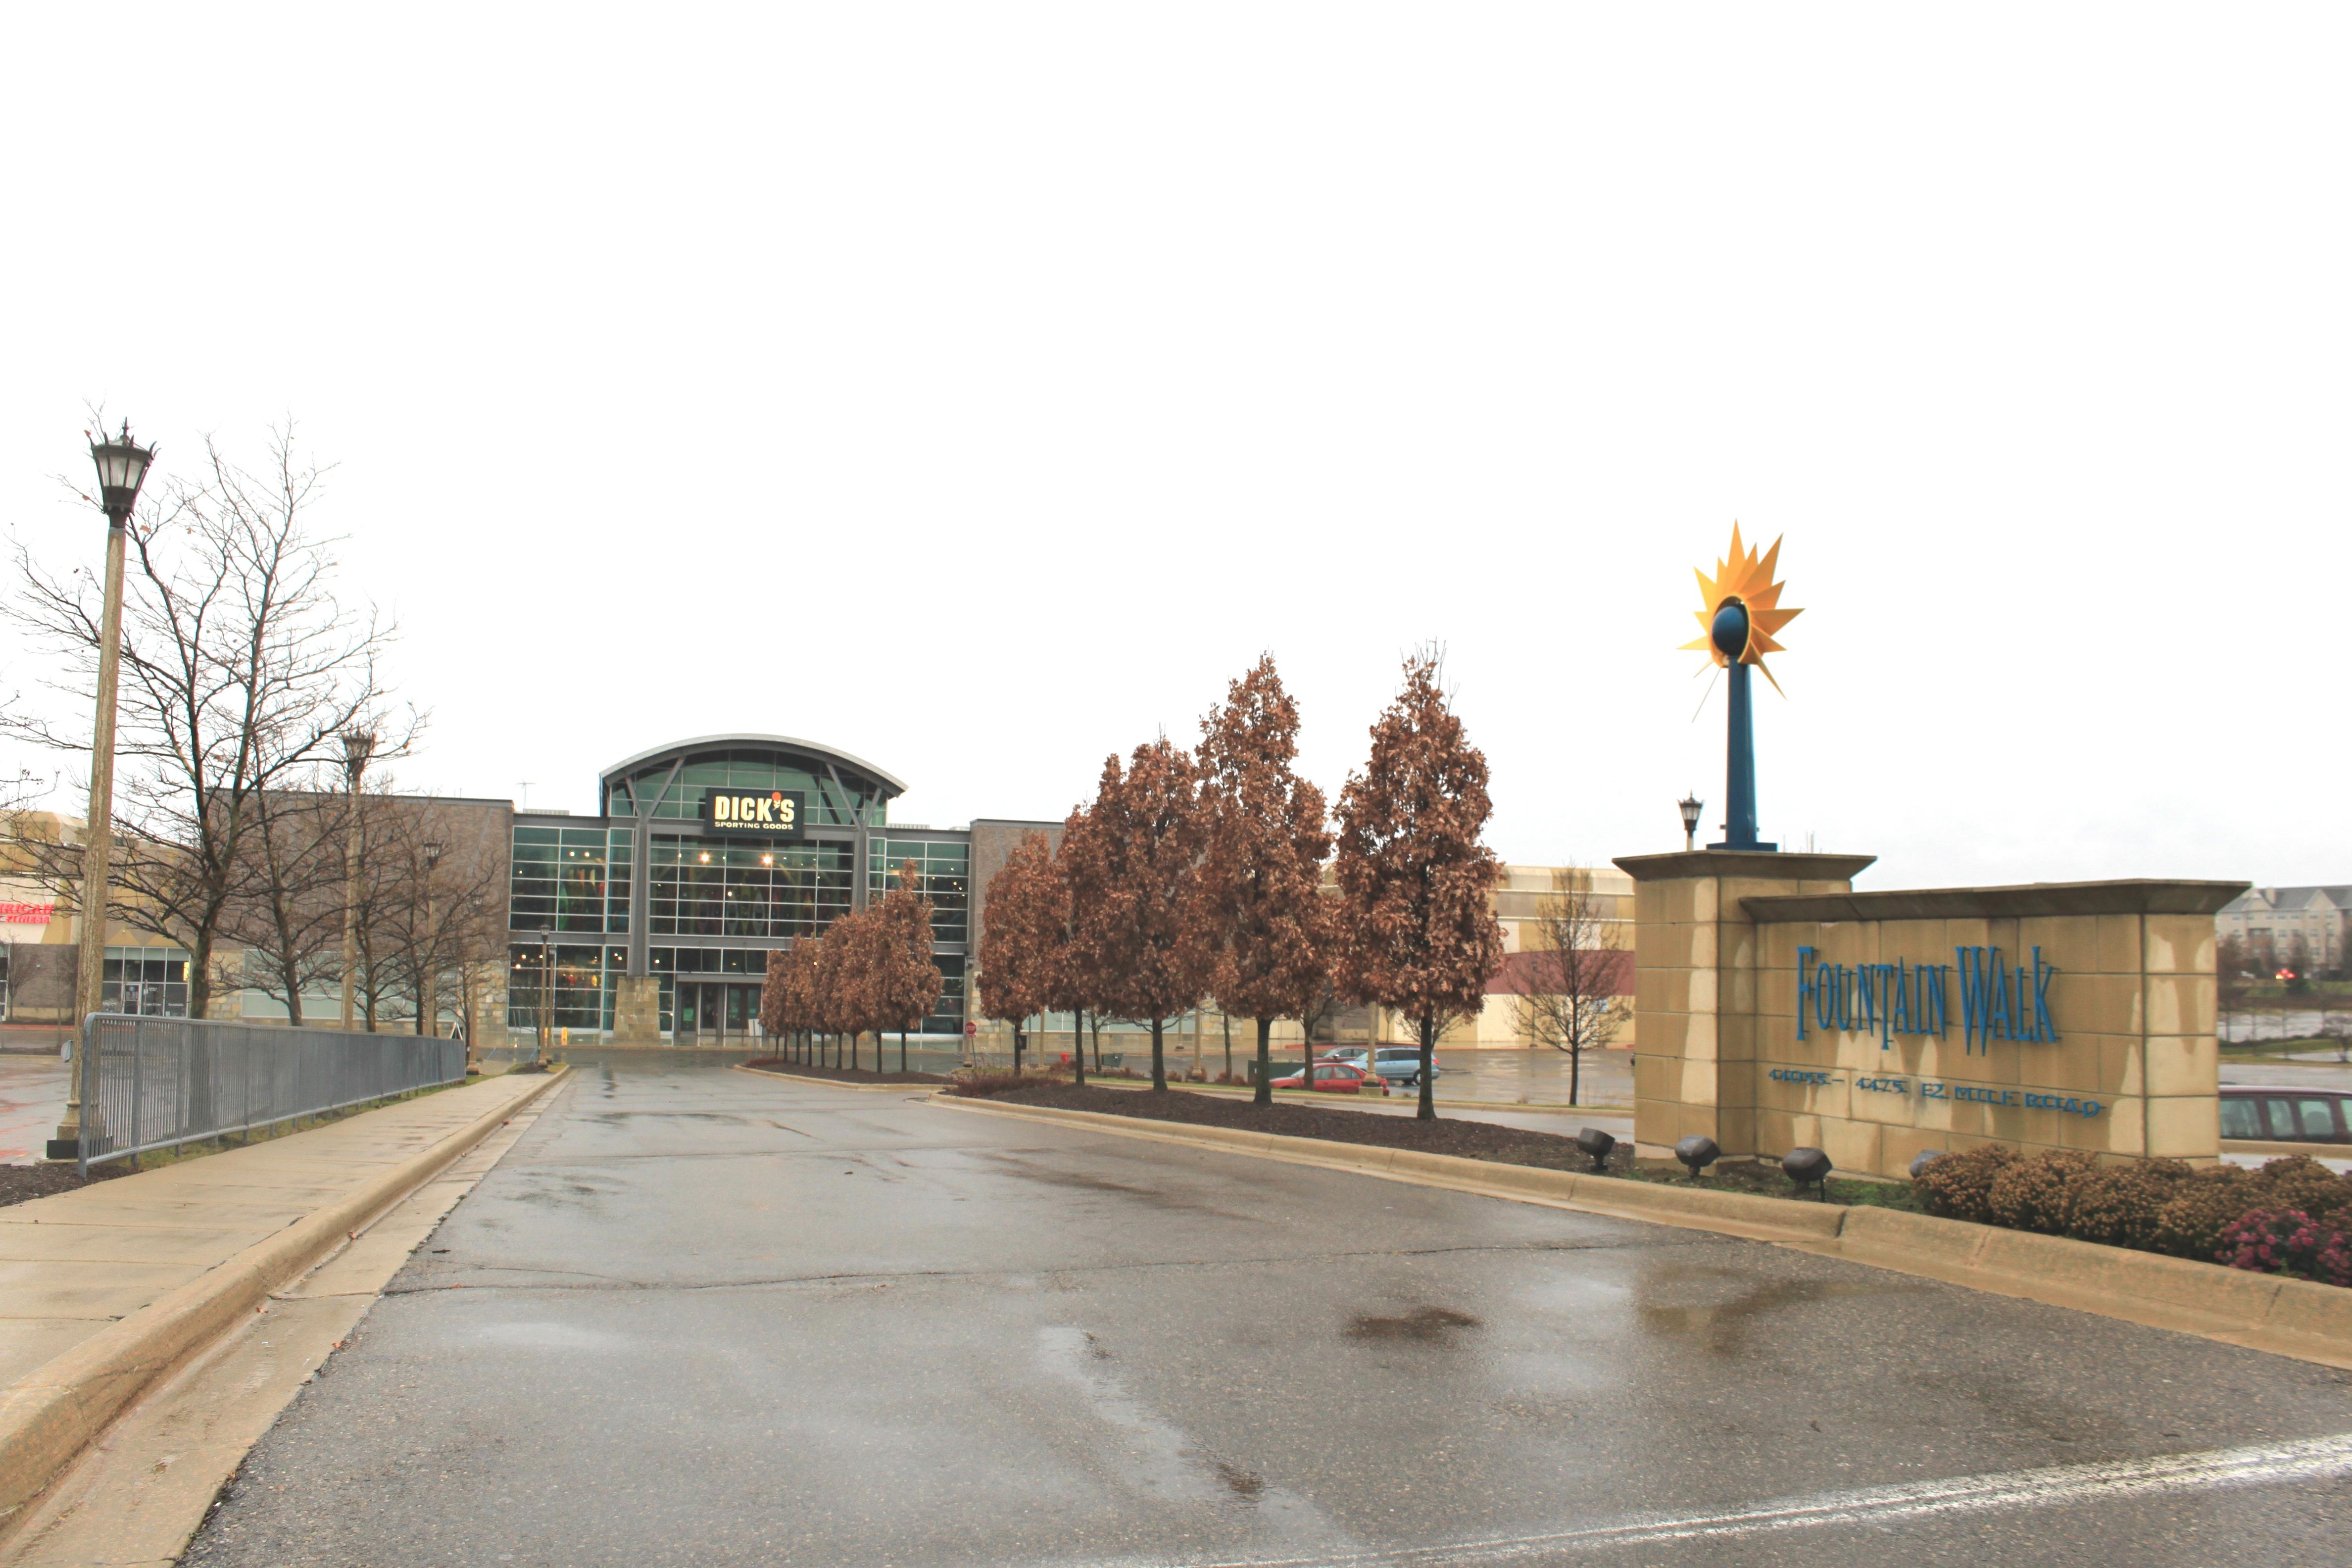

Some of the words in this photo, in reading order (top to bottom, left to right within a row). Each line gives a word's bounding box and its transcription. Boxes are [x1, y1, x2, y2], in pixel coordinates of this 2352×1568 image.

[714, 794, 795, 823] DICK'S
[1797, 946, 1947, 1050] FOUNTAIN
[1956, 946, 2058, 1057] WALK
[1955, 1085, 2019, 1106] MILE
[2024, 1092, 2102, 1118] ROAD
